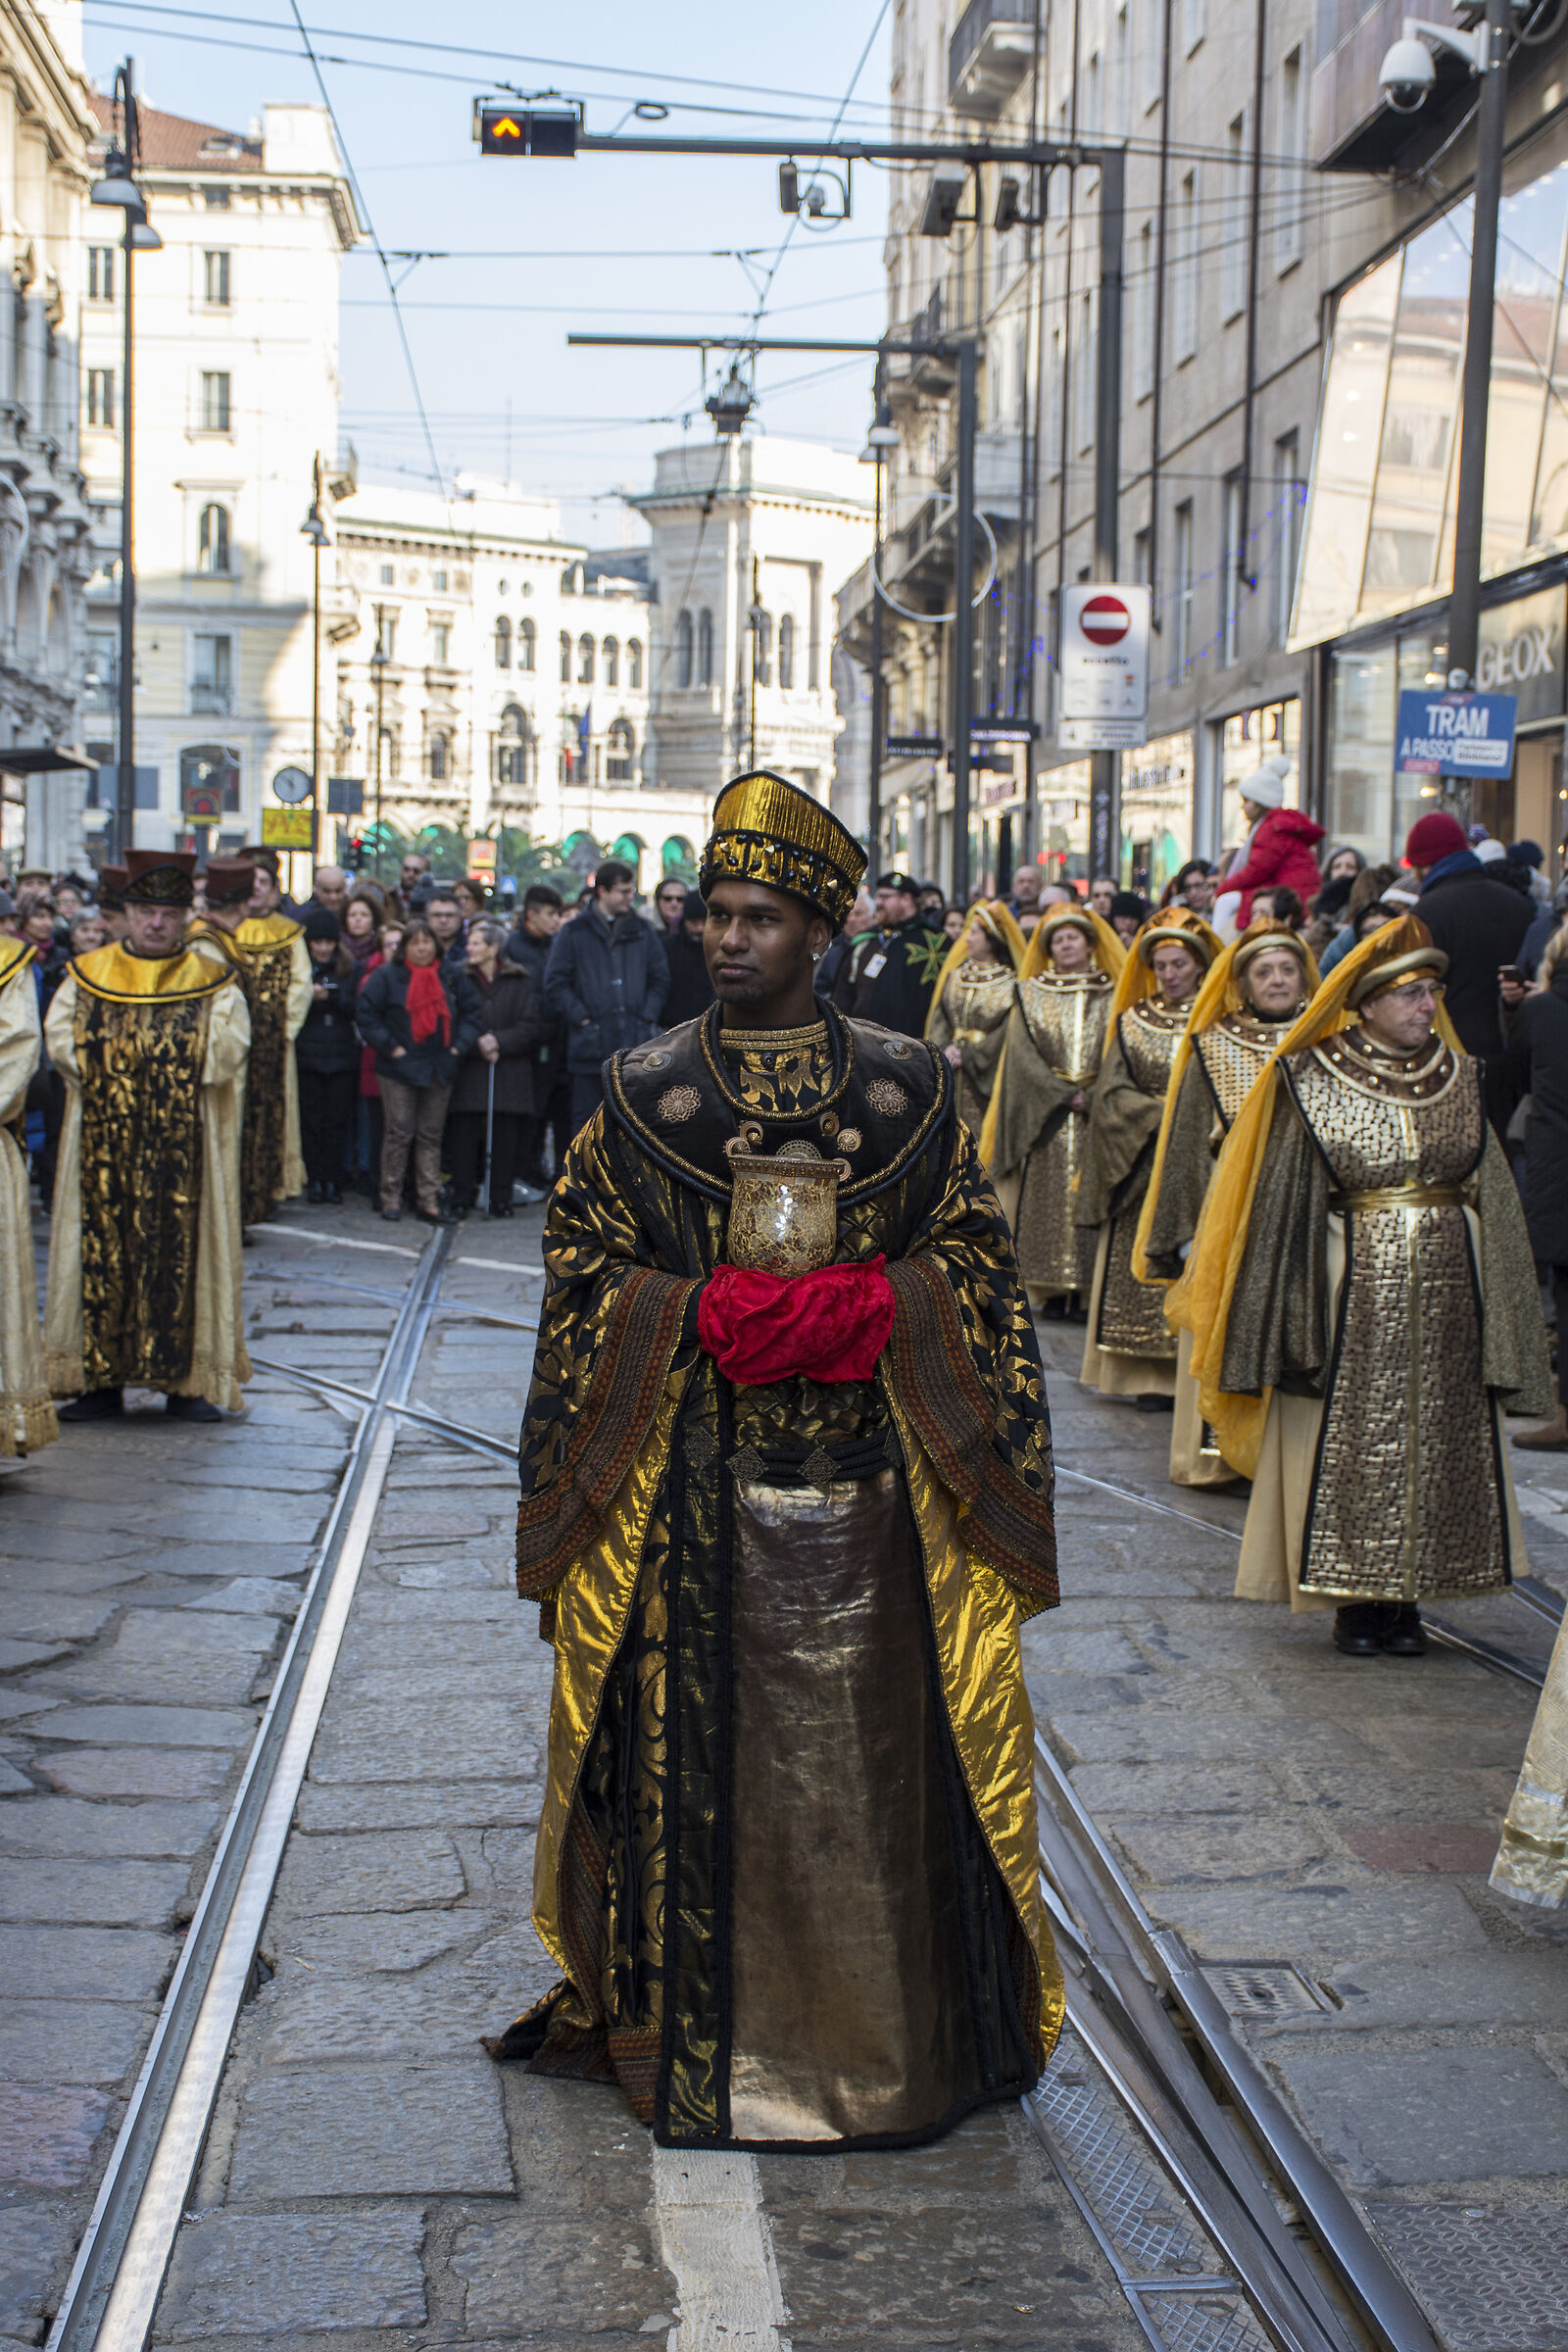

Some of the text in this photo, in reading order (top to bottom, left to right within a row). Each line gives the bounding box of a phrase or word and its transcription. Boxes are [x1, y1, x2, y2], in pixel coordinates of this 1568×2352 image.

[1477, 628, 1555, 691] GEOX
[1425, 704, 1490, 738] TRAM
[1399, 736, 1411, 758] A
[1411, 737, 1454, 761] PASSO
